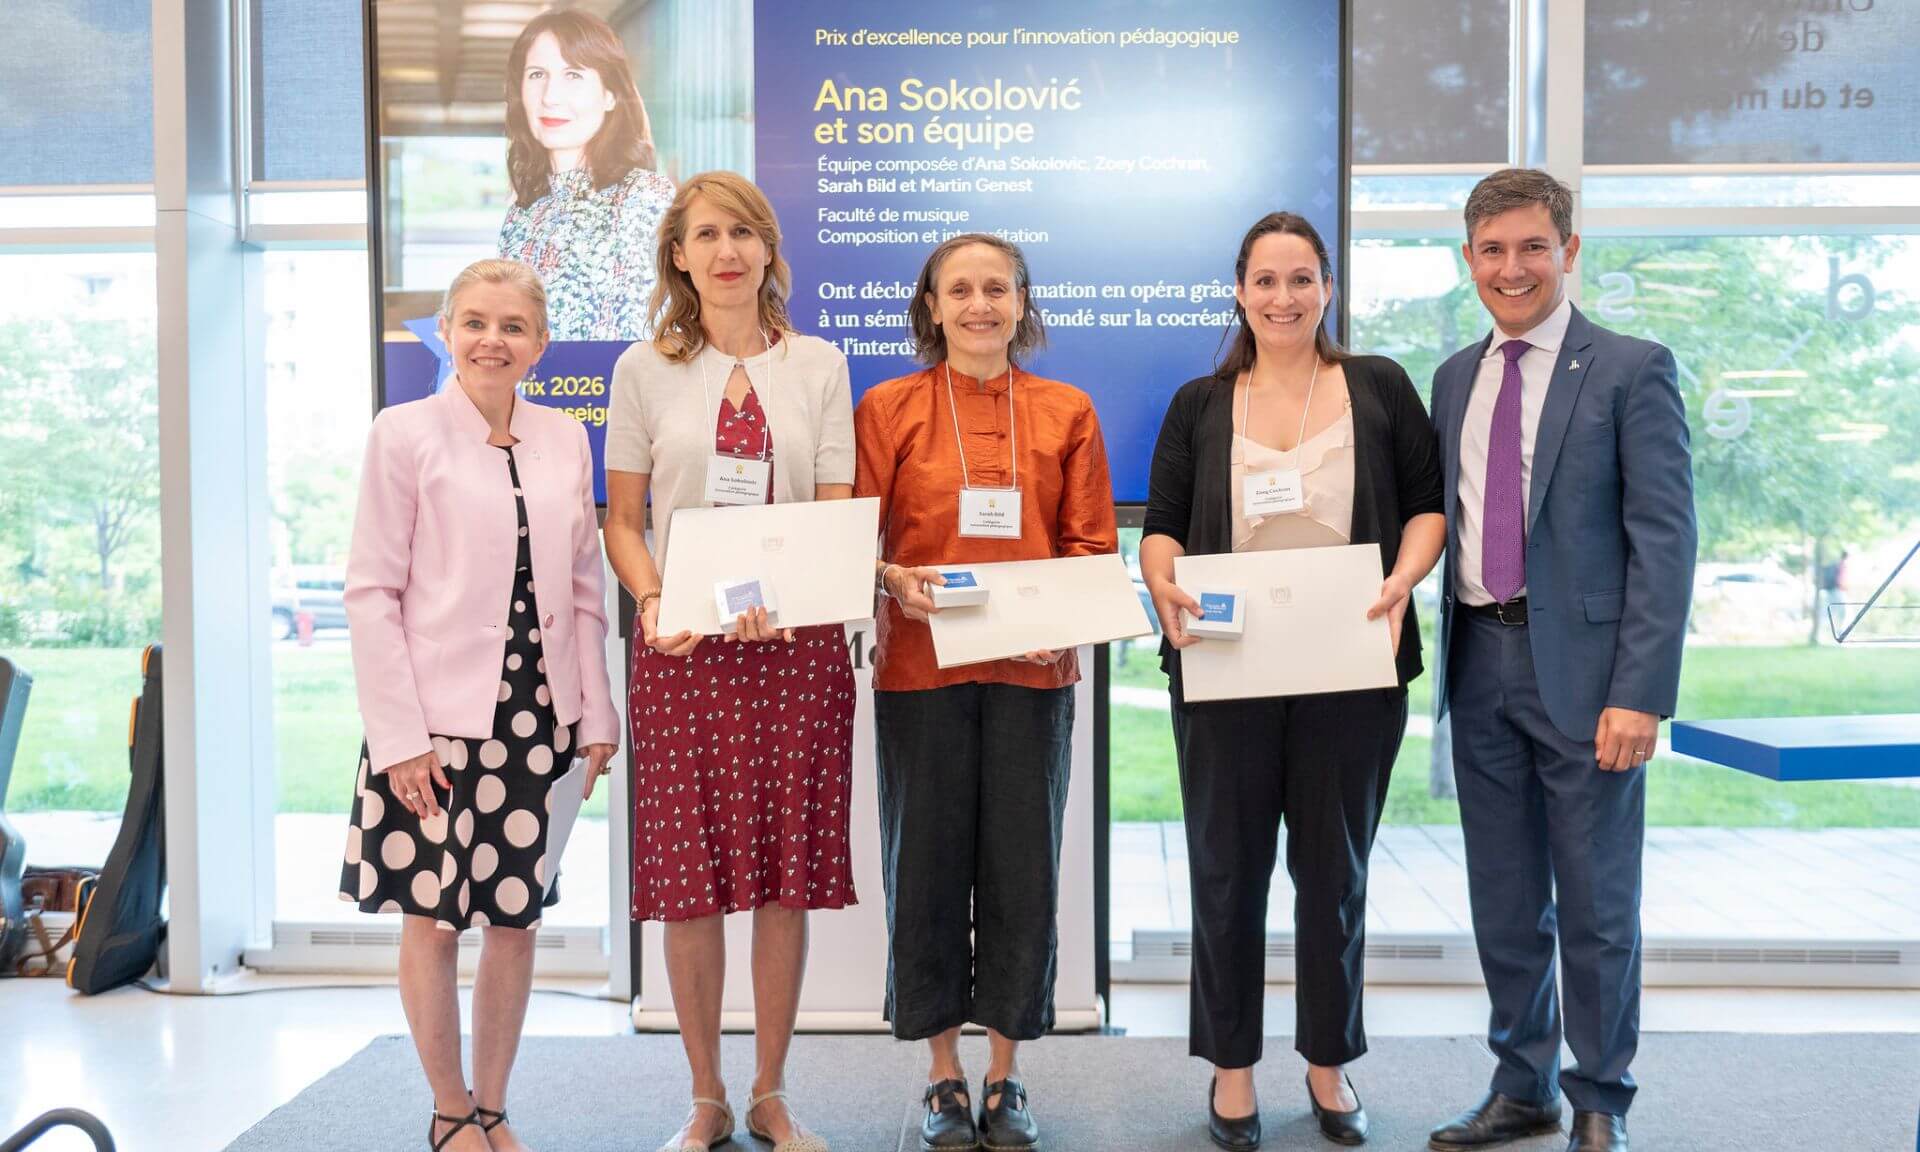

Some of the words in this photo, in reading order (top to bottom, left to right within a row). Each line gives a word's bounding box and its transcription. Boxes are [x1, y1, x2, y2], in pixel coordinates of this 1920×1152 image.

[815, 28, 848, 46] Prix
[852, 28, 962, 46] d'excellence
[967, 31, 1009, 49] pour
[1013, 27, 1115, 45] l'innovation
[1119, 27, 1240, 49] pédagogique
[813, 79, 888, 112] Ana
[899, 78, 1082, 112] Sokolović
[814, 118, 849, 145] et
[857, 123, 915, 145] son
[924, 116, 1034, 150] équipe
[818, 154, 872, 174] Équipe
[875, 156, 958, 174] composée
[960, 156, 1006, 172] d'Ana
[1094, 155, 1136, 174] Zoey
[818, 177, 863, 193] Sarah
[866, 177, 897, 193] Bild
[899, 179, 917, 193] et
[920, 177, 972, 193] Martin
[975, 177, 1033, 193] Genest
[818, 207, 875, 222] Faculté
[878, 208, 899, 222] de
[903, 208, 970, 224] musique
[818, 228, 918, 246] Composition
[922, 228, 939, 243] et
[818, 282, 857, 300] Ont
[860, 280, 918, 300] décloi
[1028, 281, 1098, 299] mation
[1101, 284, 1126, 299] en
[1130, 280, 1186, 304] opéra
[818, 308, 831, 328] à
[834, 314, 860, 328] un
[864, 309, 912, 328] sémi
[1041, 308, 1096, 327] fondé
[1099, 313, 1131, 327] sur
[1134, 308, 1153, 327] la
[1156, 308, 1238, 327] cocréati
[520, 377, 547, 396] rix
[550, 376, 606, 397] 2026
